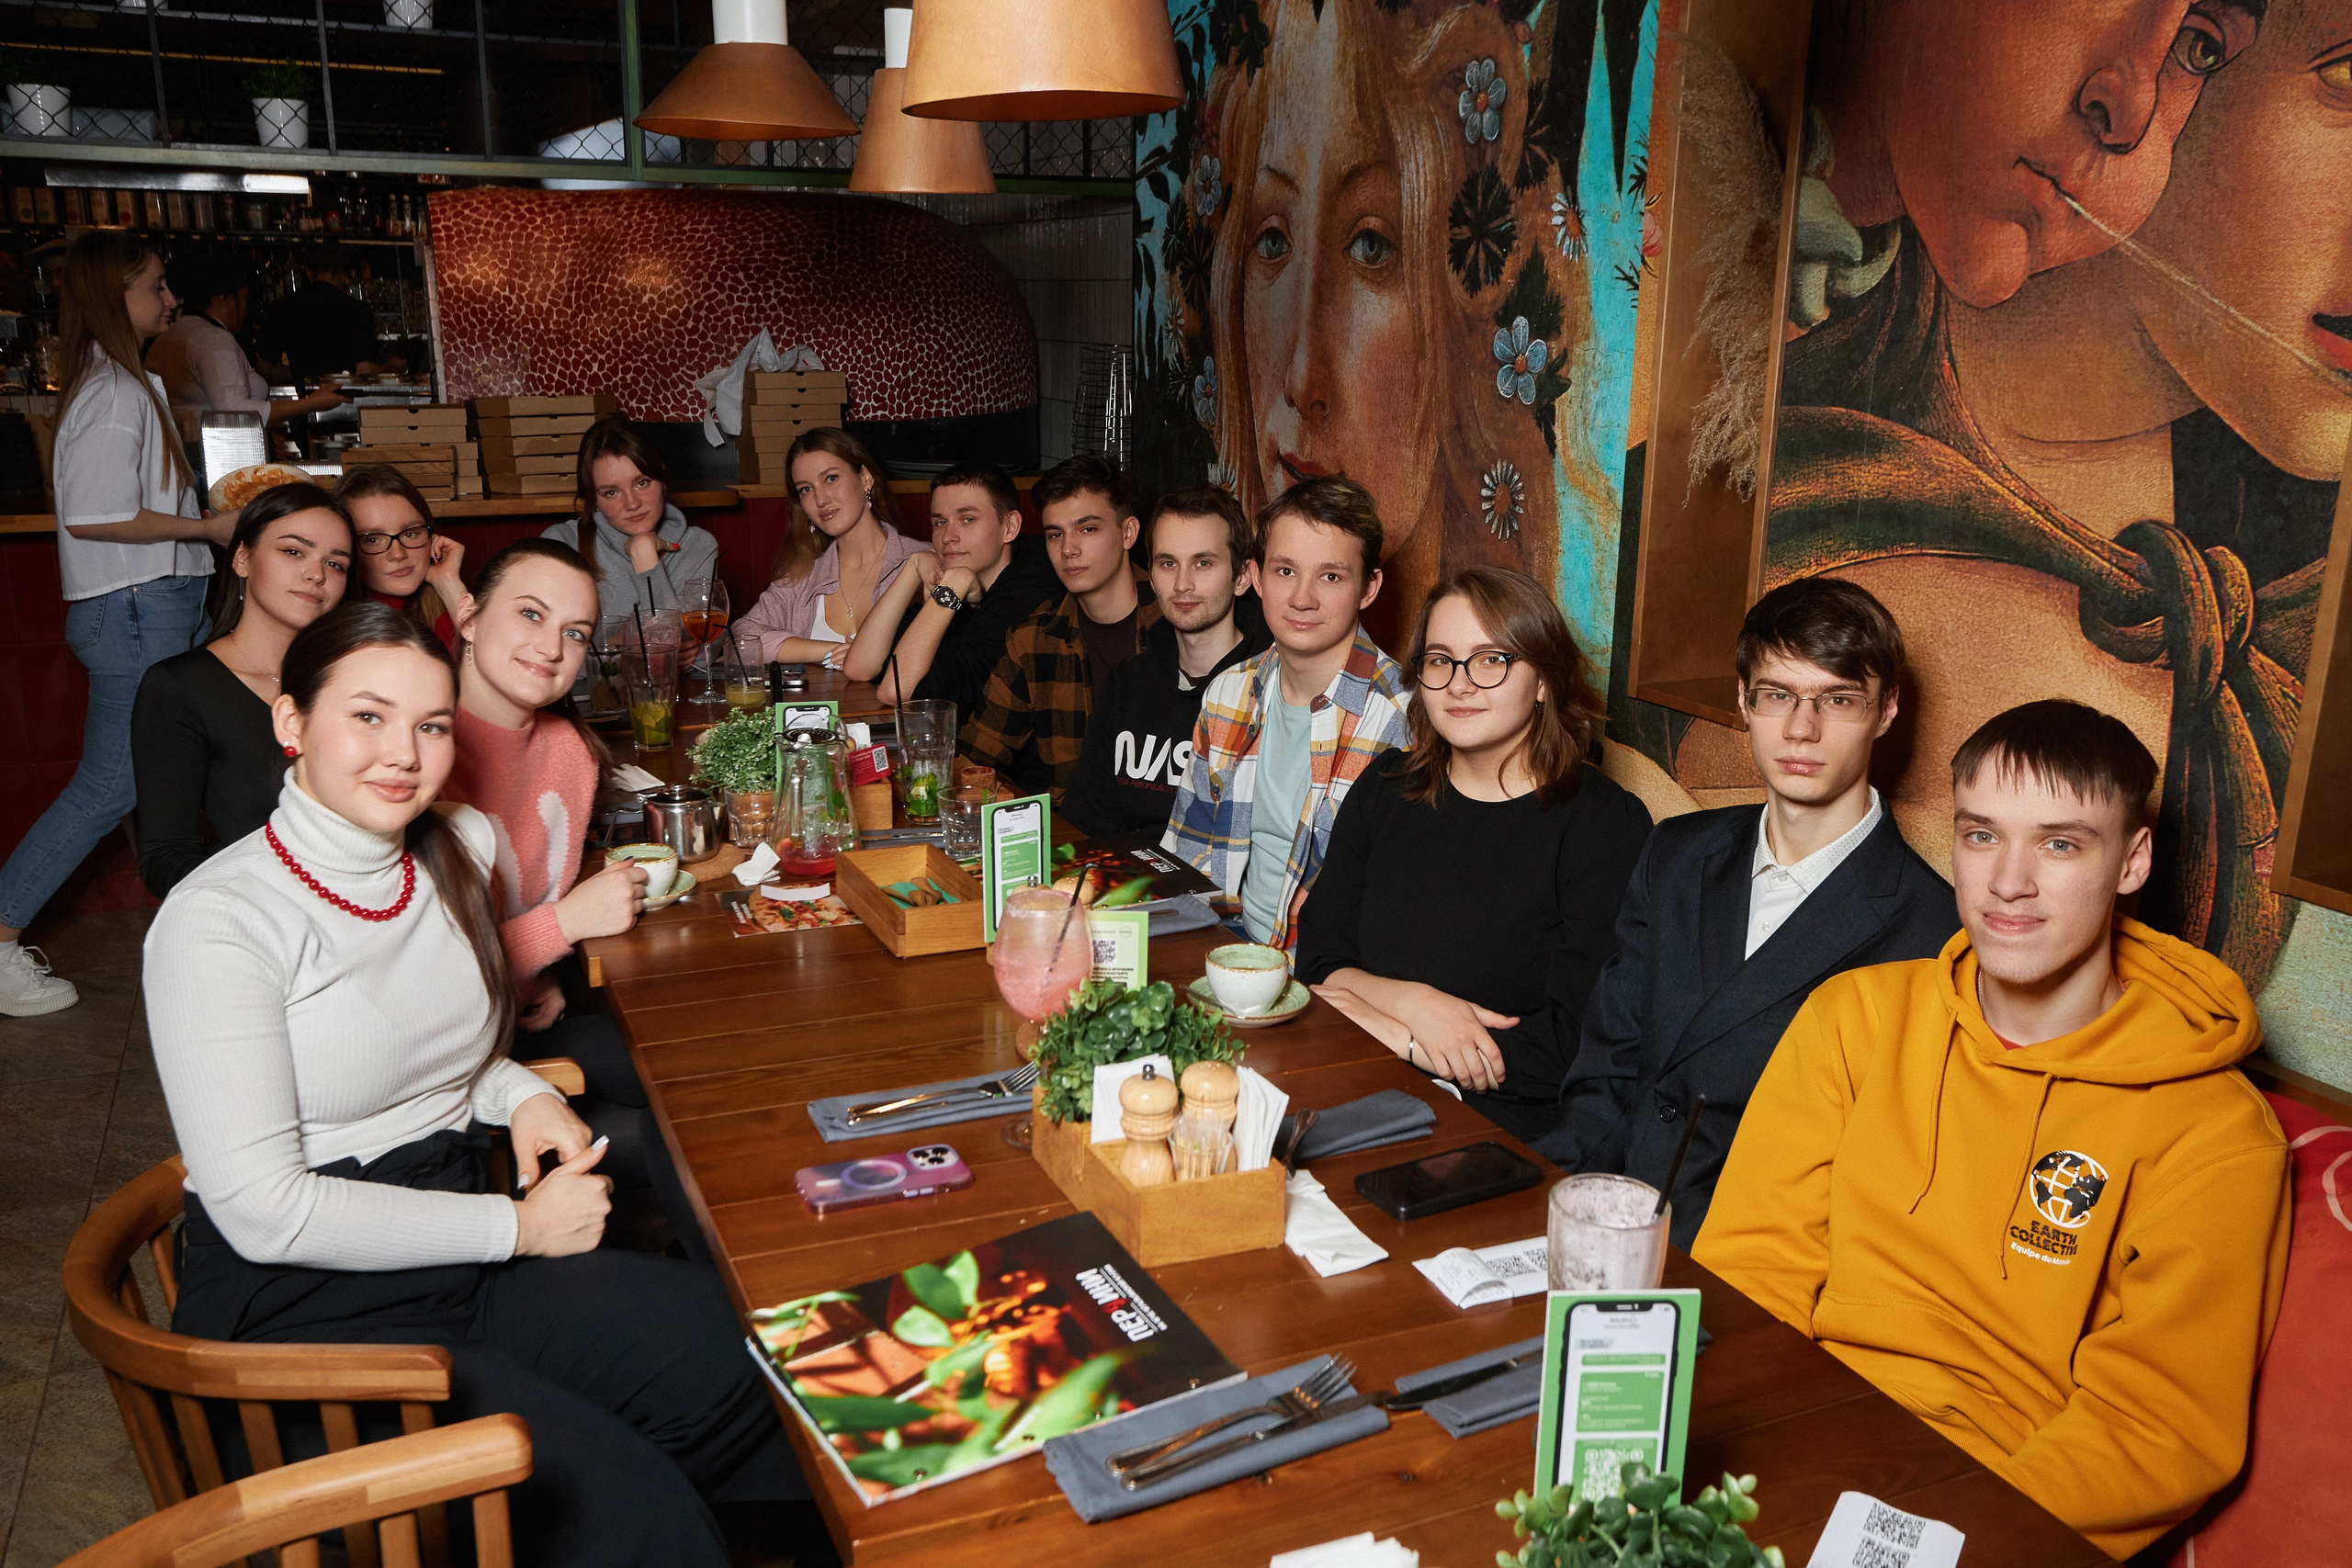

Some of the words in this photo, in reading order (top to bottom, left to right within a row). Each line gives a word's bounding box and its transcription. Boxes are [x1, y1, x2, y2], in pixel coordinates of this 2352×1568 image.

[2030, 1220, 2077, 1245] EARTH
[2010, 1241, 2041, 1259] Equipe
[2041, 1255, 2052, 1263] du
